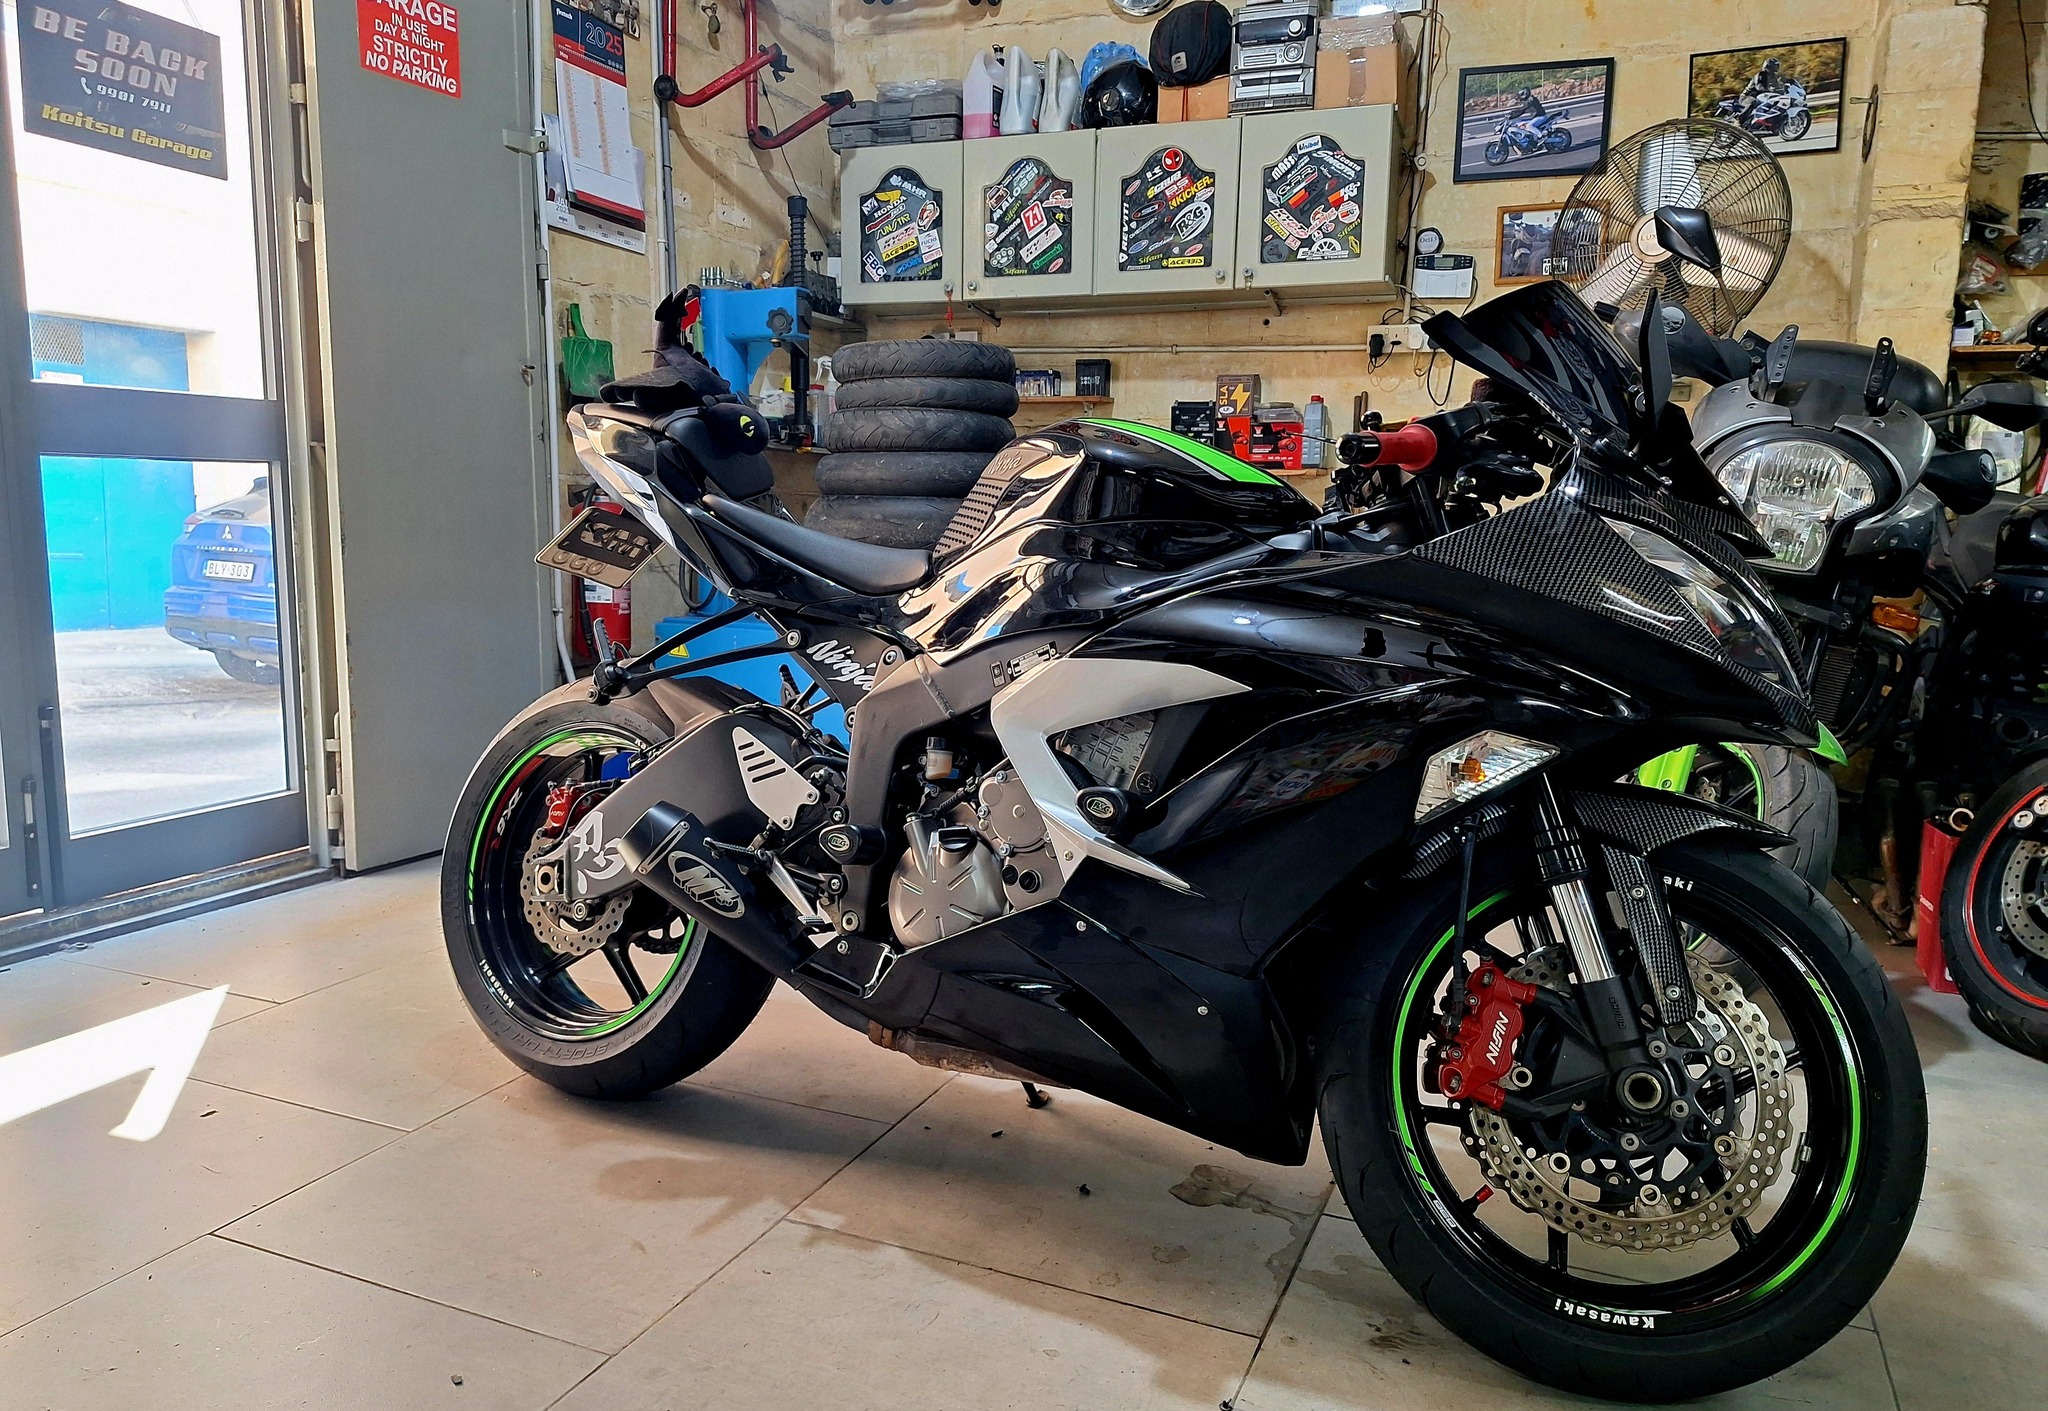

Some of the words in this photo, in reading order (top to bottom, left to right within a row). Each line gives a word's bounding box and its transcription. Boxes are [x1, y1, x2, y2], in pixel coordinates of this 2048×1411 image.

[375, 18, 397, 37] DAY
[400, 28, 409, 41] &
[411, 32, 445, 53] NIGHT
[391, 12, 403, 27] IN
[406, 18, 428, 36] USE
[585, 21, 623, 56] 2025
[34, 6, 89, 42] BE
[105, 29, 208, 80] BACK
[373, 34, 448, 74] STRICTLY
[74, 48, 177, 97] SOON
[366, 50, 389, 71] NO
[392, 59, 457, 93] PARKING
[140, 96, 171, 114] 7911
[41, 104, 125, 138] Keitsu
[131, 128, 213, 161] Garage
[874, 195, 907, 218] HONDA
[1176, 177, 1209, 206] KICKER
[865, 255, 885, 277] EBC
[1219, 385, 1228, 405] SLA
[806, 639, 878, 690] Ninja
[480, 959, 514, 1008] Kawasaki
[1555, 1298, 1655, 1329] Kawasaki
